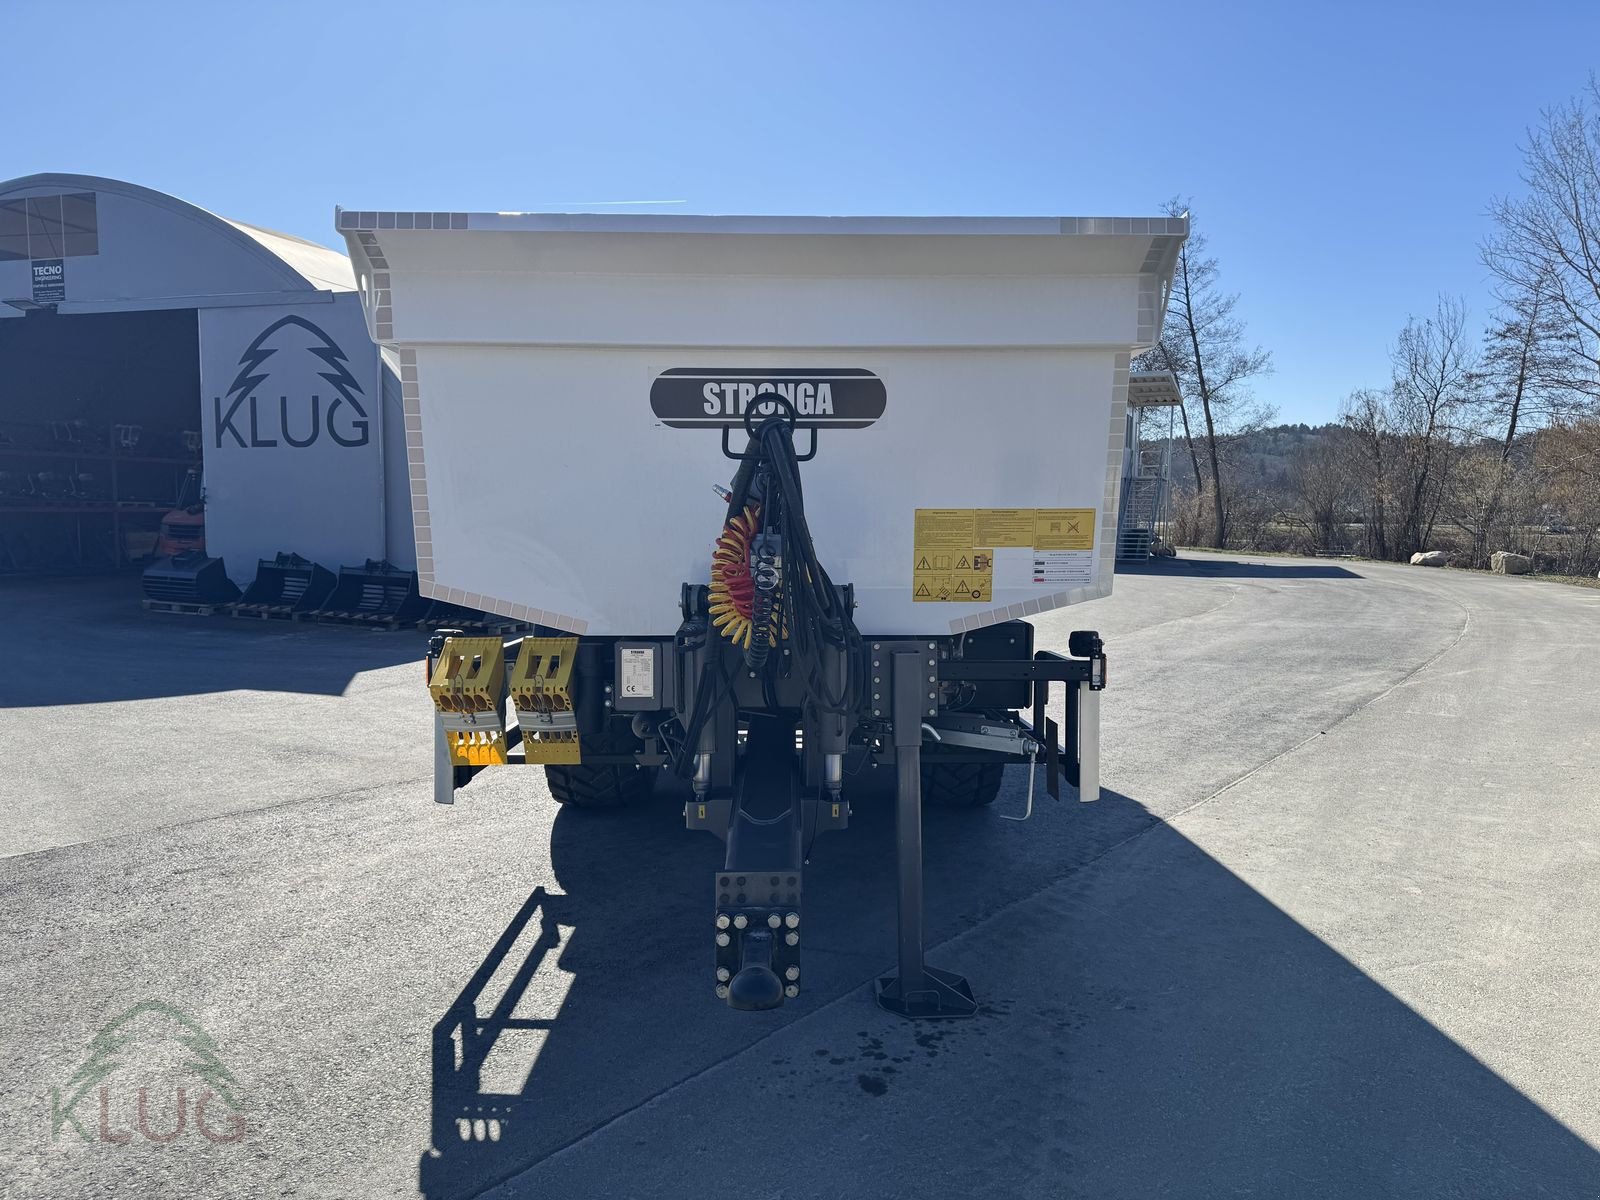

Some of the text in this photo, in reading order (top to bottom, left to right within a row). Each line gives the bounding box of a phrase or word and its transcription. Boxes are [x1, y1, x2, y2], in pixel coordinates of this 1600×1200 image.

[33, 265, 62, 275] TECNO
[702, 382, 834, 415] STRONGA
[214, 395, 369, 448] KLUG
